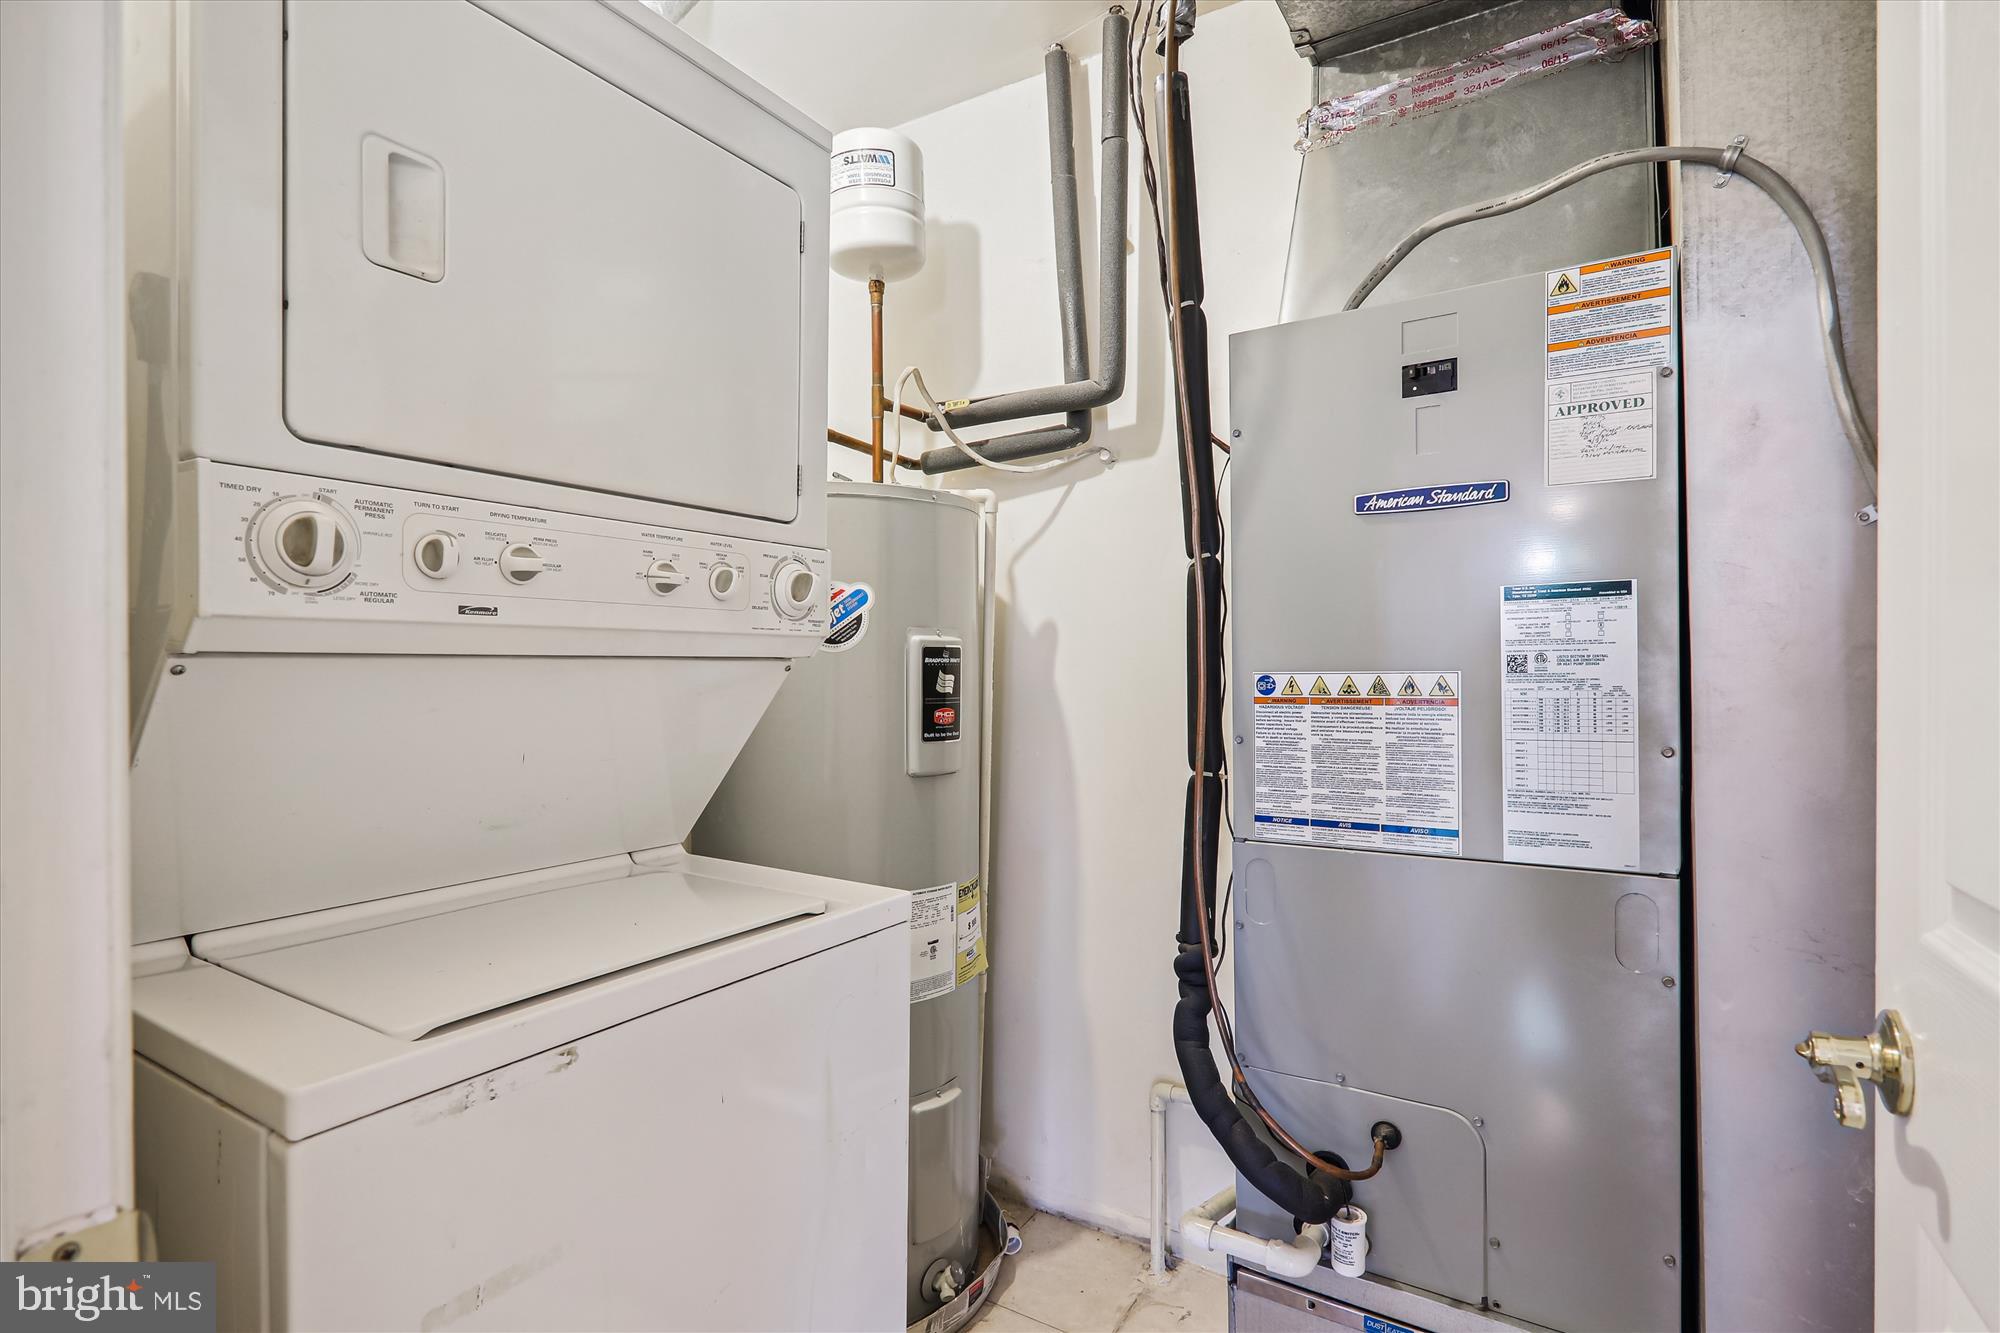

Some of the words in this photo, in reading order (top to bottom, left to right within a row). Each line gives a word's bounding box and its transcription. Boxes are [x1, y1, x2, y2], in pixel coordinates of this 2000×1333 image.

[1411, 75, 1456, 96] Nashua
[1462, 63, 1490, 80] 324A
[1541, 37, 1568, 52] 06/15
[1412, 91, 1457, 111] Nashua
[1463, 80, 1491, 96] 324A
[1541, 52, 1569, 69] 06/15
[843, 153, 878, 166] WATTS
[1610, 256, 1646, 268] WARNING
[1581, 293, 1641, 308] AVERTISSEMENT
[1586, 332, 1638, 345] ADVERTENCIA
[1555, 397, 1645, 418] APPROVED
[219, 482, 244, 491] TIMED
[246, 485, 262, 493] DRY
[1363, 494, 1424, 511] American
[1426, 484, 1498, 505] Standard
[354, 499, 394, 509] AUTOMATIC
[354, 505, 395, 515] PERMANENT
[413, 501, 430, 509] TURN
[441, 505, 460, 513] START
[365, 512, 386, 520] PRESS
[490, 512, 510, 520] DRYING
[511, 515, 547, 524] TEMPERATURE
[360, 591, 398, 599] AUTOMATIC
[465, 608, 498, 616] Kenmore
[1366, 1320, 1385, 1331] DUST
